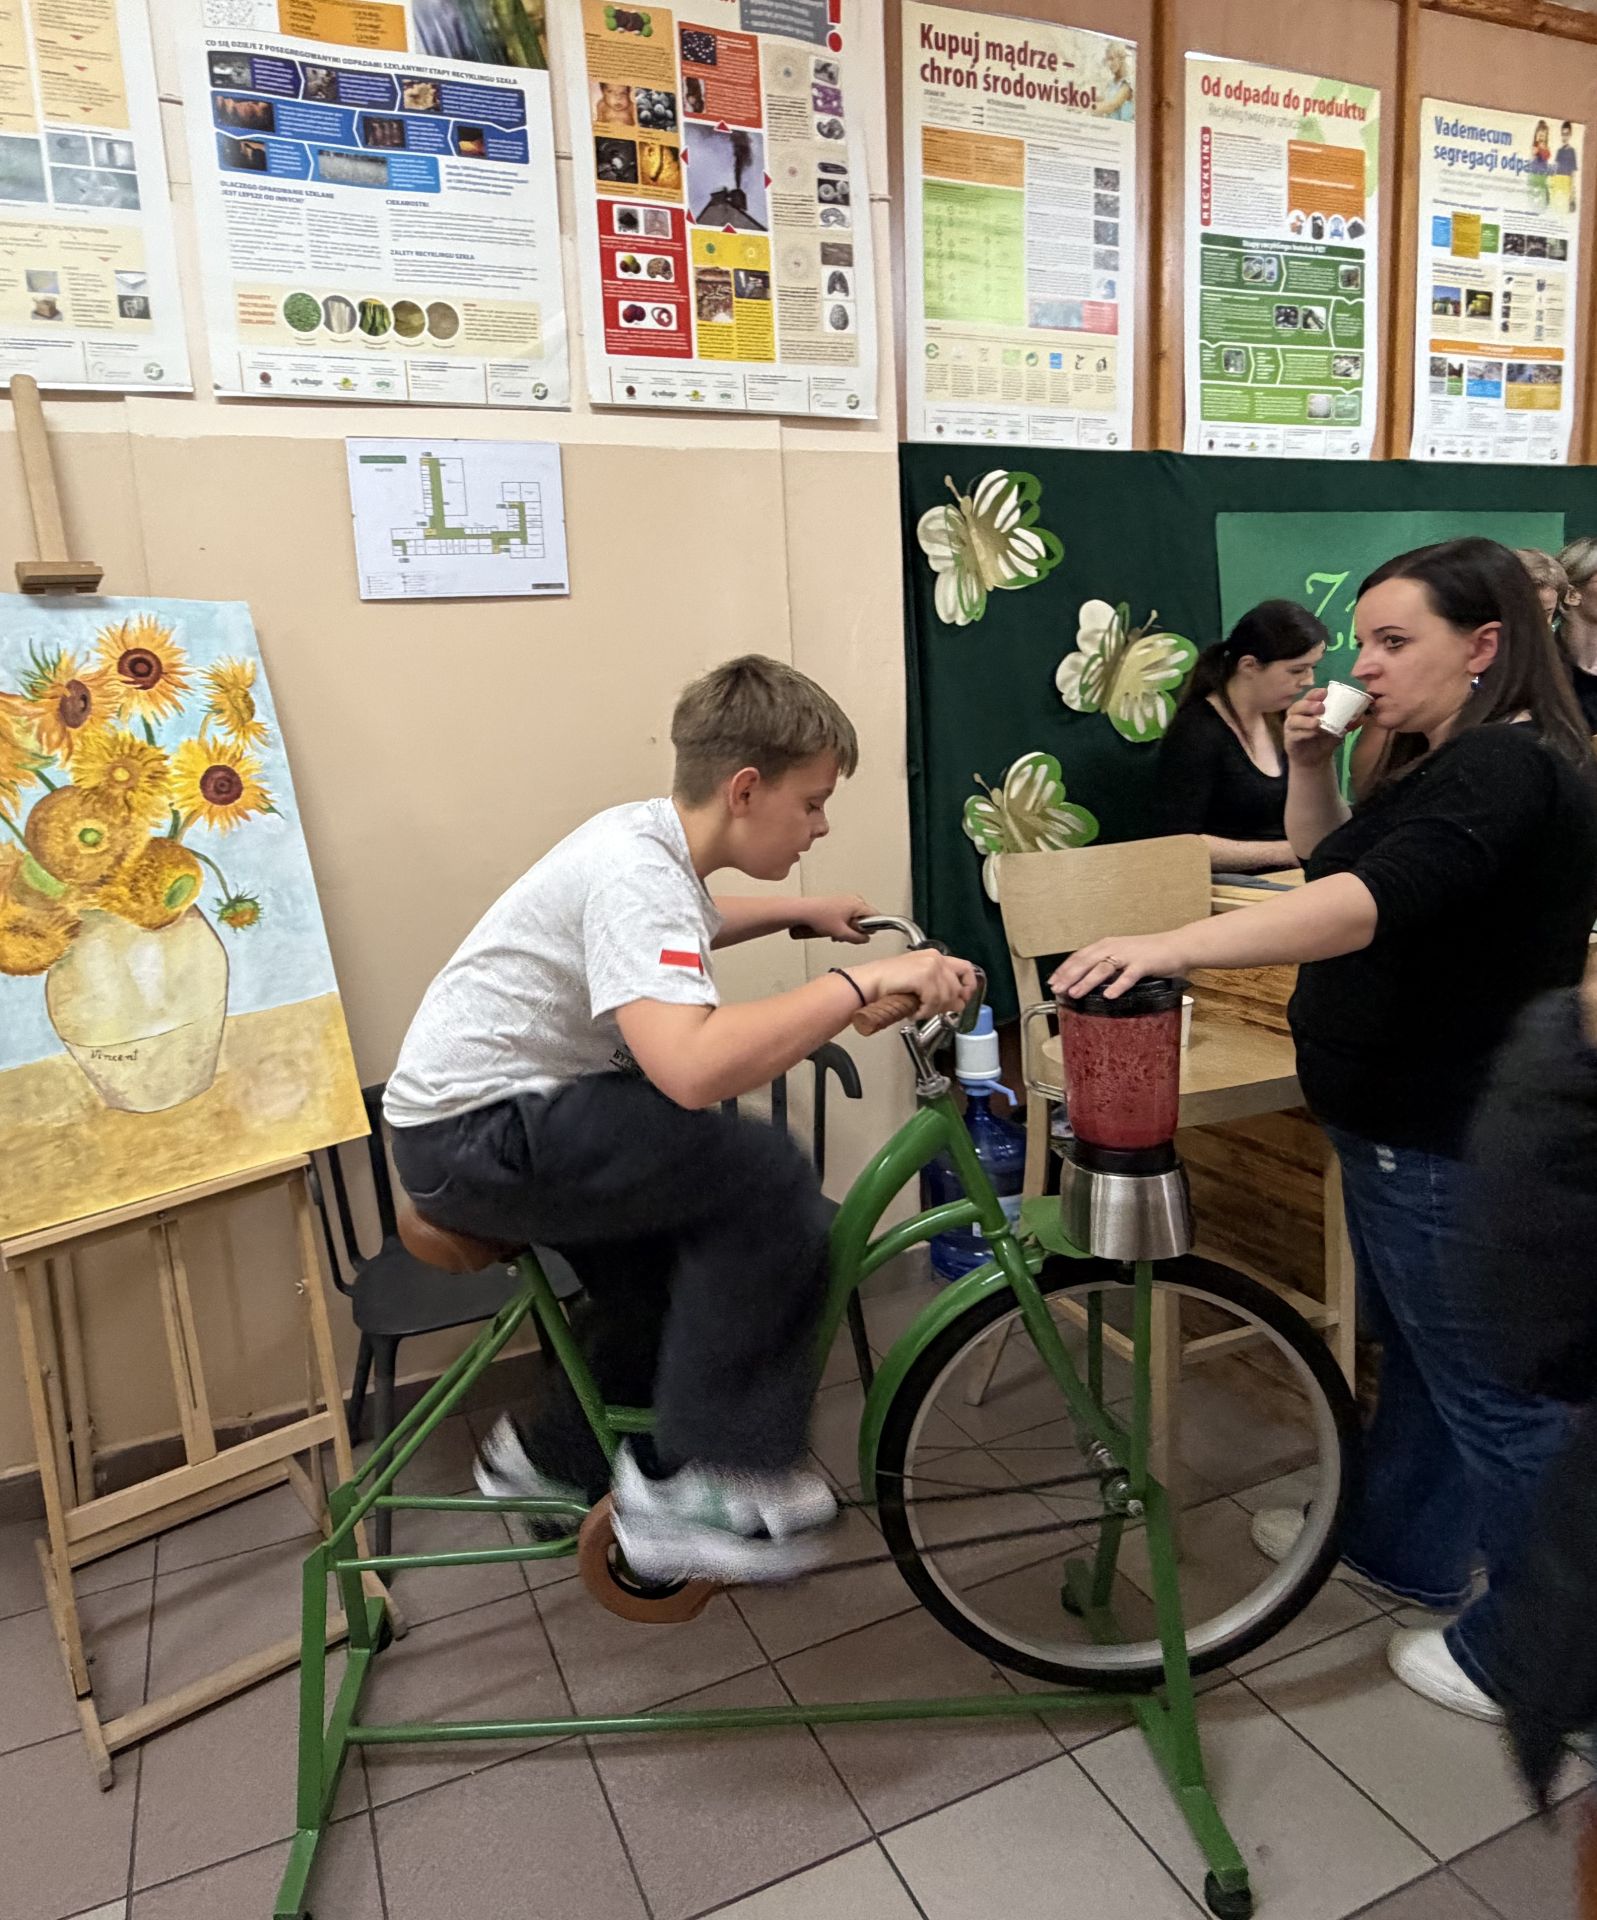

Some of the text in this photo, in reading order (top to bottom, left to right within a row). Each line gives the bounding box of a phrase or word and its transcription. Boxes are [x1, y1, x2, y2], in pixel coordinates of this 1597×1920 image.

[920, 23, 980, 64] Kupuj
[985, 40, 1058, 72] mądrze
[920, 57, 978, 89] chroń
[983, 66, 1097, 110] środowisko!
[1201, 75, 1367, 121] Od odpadu do produktu
[1434, 116, 1512, 146] Vademecum
[1202, 132, 1211, 220] RECYKLING
[1433, 145, 1498, 172] segregacji
[90, 1048, 138, 1062] Vincent
